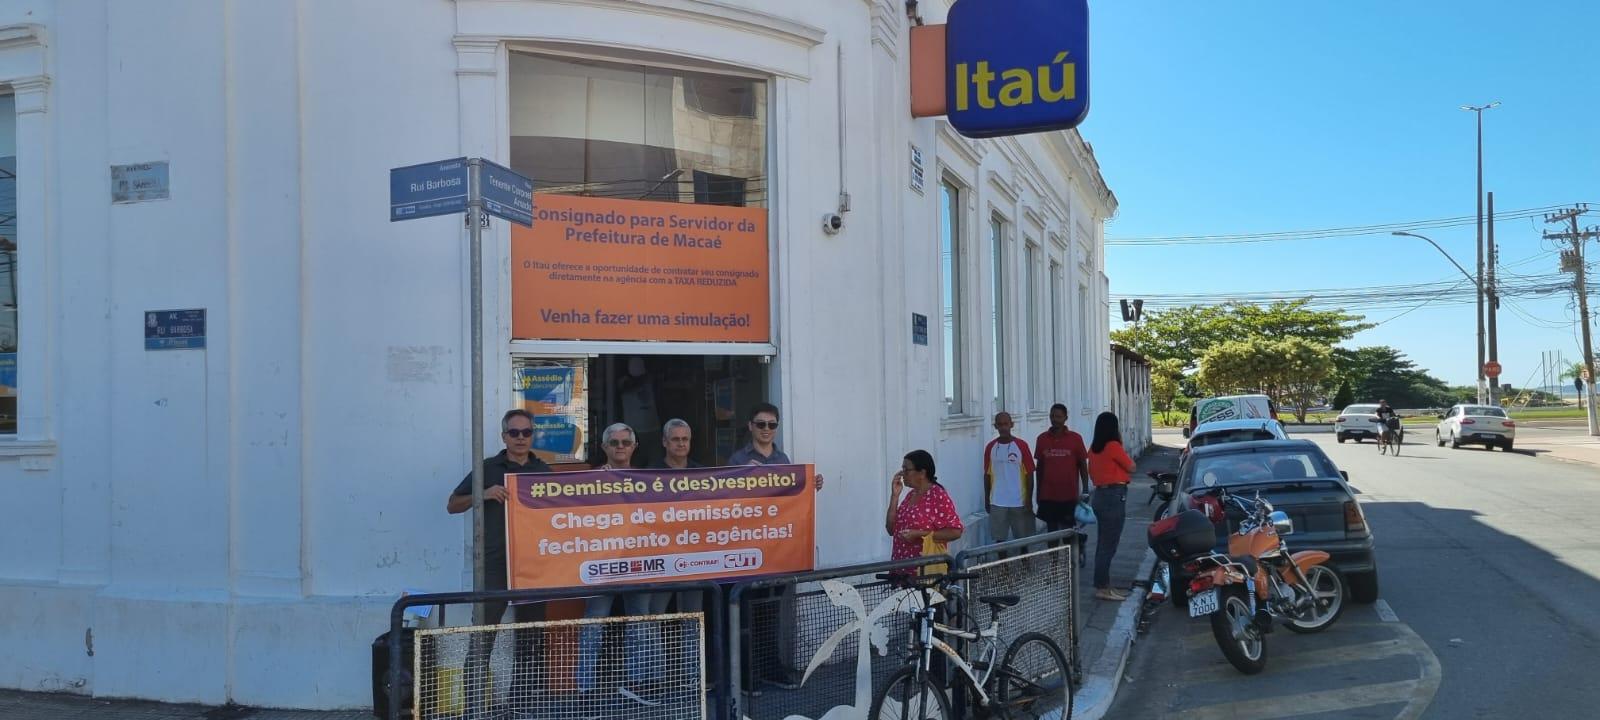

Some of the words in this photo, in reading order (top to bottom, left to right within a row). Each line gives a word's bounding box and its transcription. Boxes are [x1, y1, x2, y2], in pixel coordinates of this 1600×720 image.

[956, 51, 1076, 111] Itaú
[410, 183, 425, 192] Rui
[426, 177, 461, 190] Barbosa
[630, 214, 665, 229] para
[669, 215, 734, 231] Servidor
[737, 218, 756, 233] da
[565, 227, 646, 245] Prefeitura
[650, 232, 669, 246] de
[673, 234, 722, 248] Macaé
[549, 271, 601, 282] diretamente
[675, 277, 695, 286] TAXA
[696, 277, 737, 286] REDUZIDA
[552, 261, 584, 271] oferece
[593, 263, 649, 274] oportunidade
[651, 265, 661, 274] de
[663, 267, 698, 276] contratar
[716, 269, 759, 279] consignado
[540, 308, 591, 324] Venha
[595, 309, 633, 324] fazer
[637, 313, 670, 325] uma
[674, 312, 750, 330] simulação!
[530, 477, 647, 497] #Demissão
[652, 477, 664, 492] é
[669, 473, 796, 493] (des)respeito!
[551, 512, 624, 529] Chega
[630, 508, 656, 524] de
[662, 504, 763, 523] demissões
[767, 504, 778, 517] e
[538, 532, 671, 555] fechamento
[675, 529, 700, 545] de
[705, 523, 793, 545] agências!
[588, 561, 629, 576] SEEB
[643, 558, 665, 572] MR
[724, 553, 757, 568] CUT
